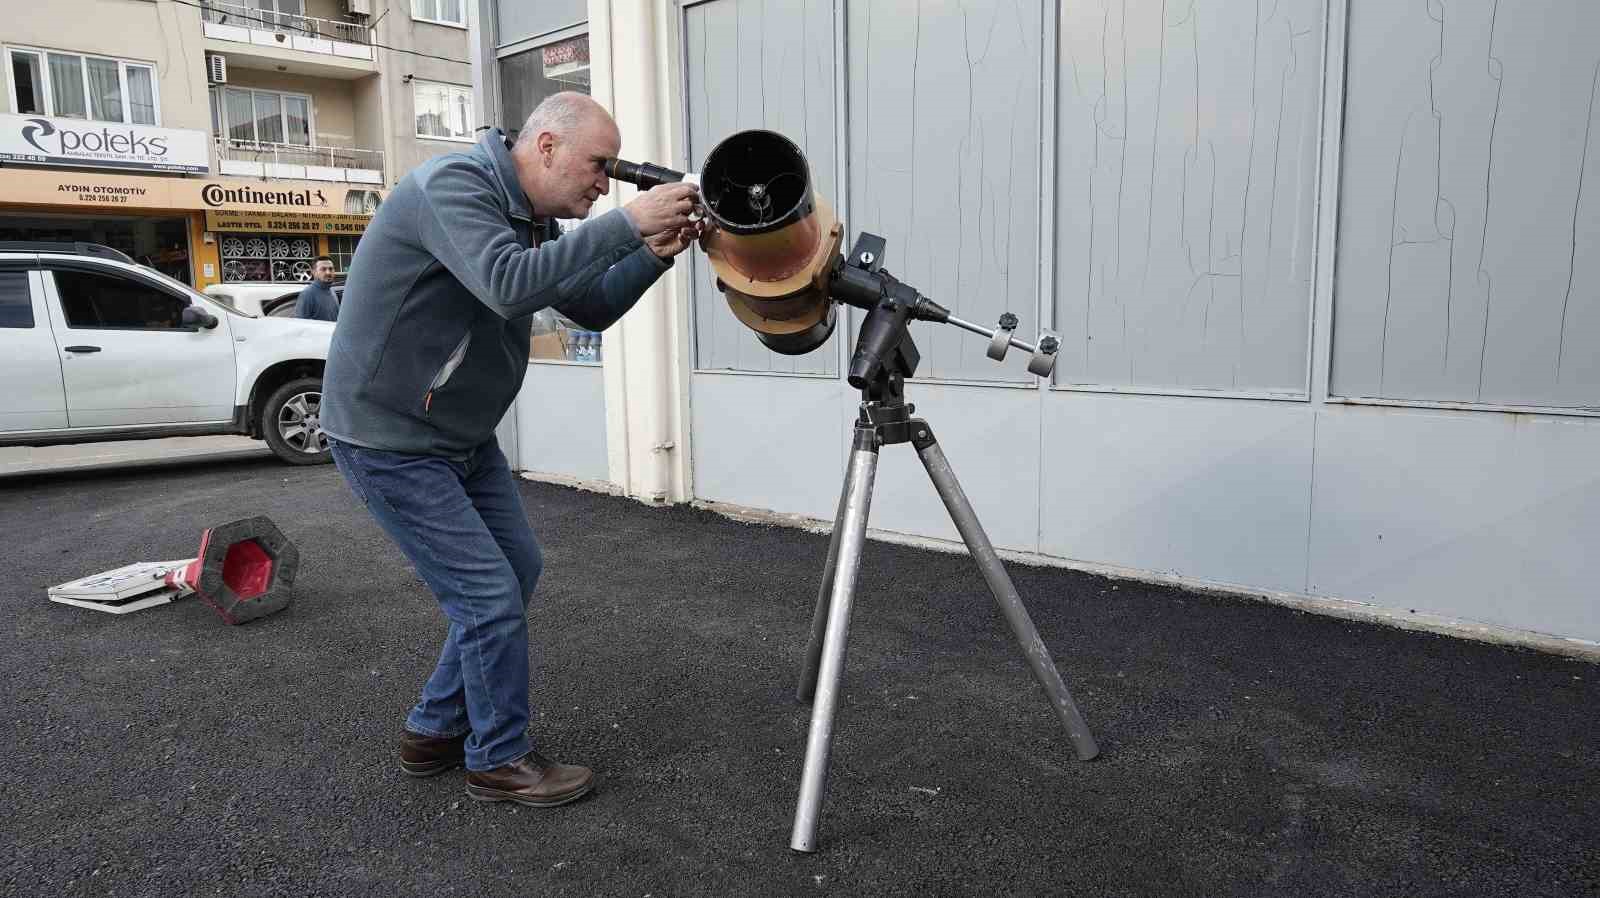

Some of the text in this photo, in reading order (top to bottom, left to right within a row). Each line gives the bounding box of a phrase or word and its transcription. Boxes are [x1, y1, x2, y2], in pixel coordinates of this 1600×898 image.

[59, 128, 168, 156] poteks
[57, 184, 146, 195] AYDIN OTOMOTİV
[202, 184, 311, 207] Continental
[312, 222, 320, 230] 27
